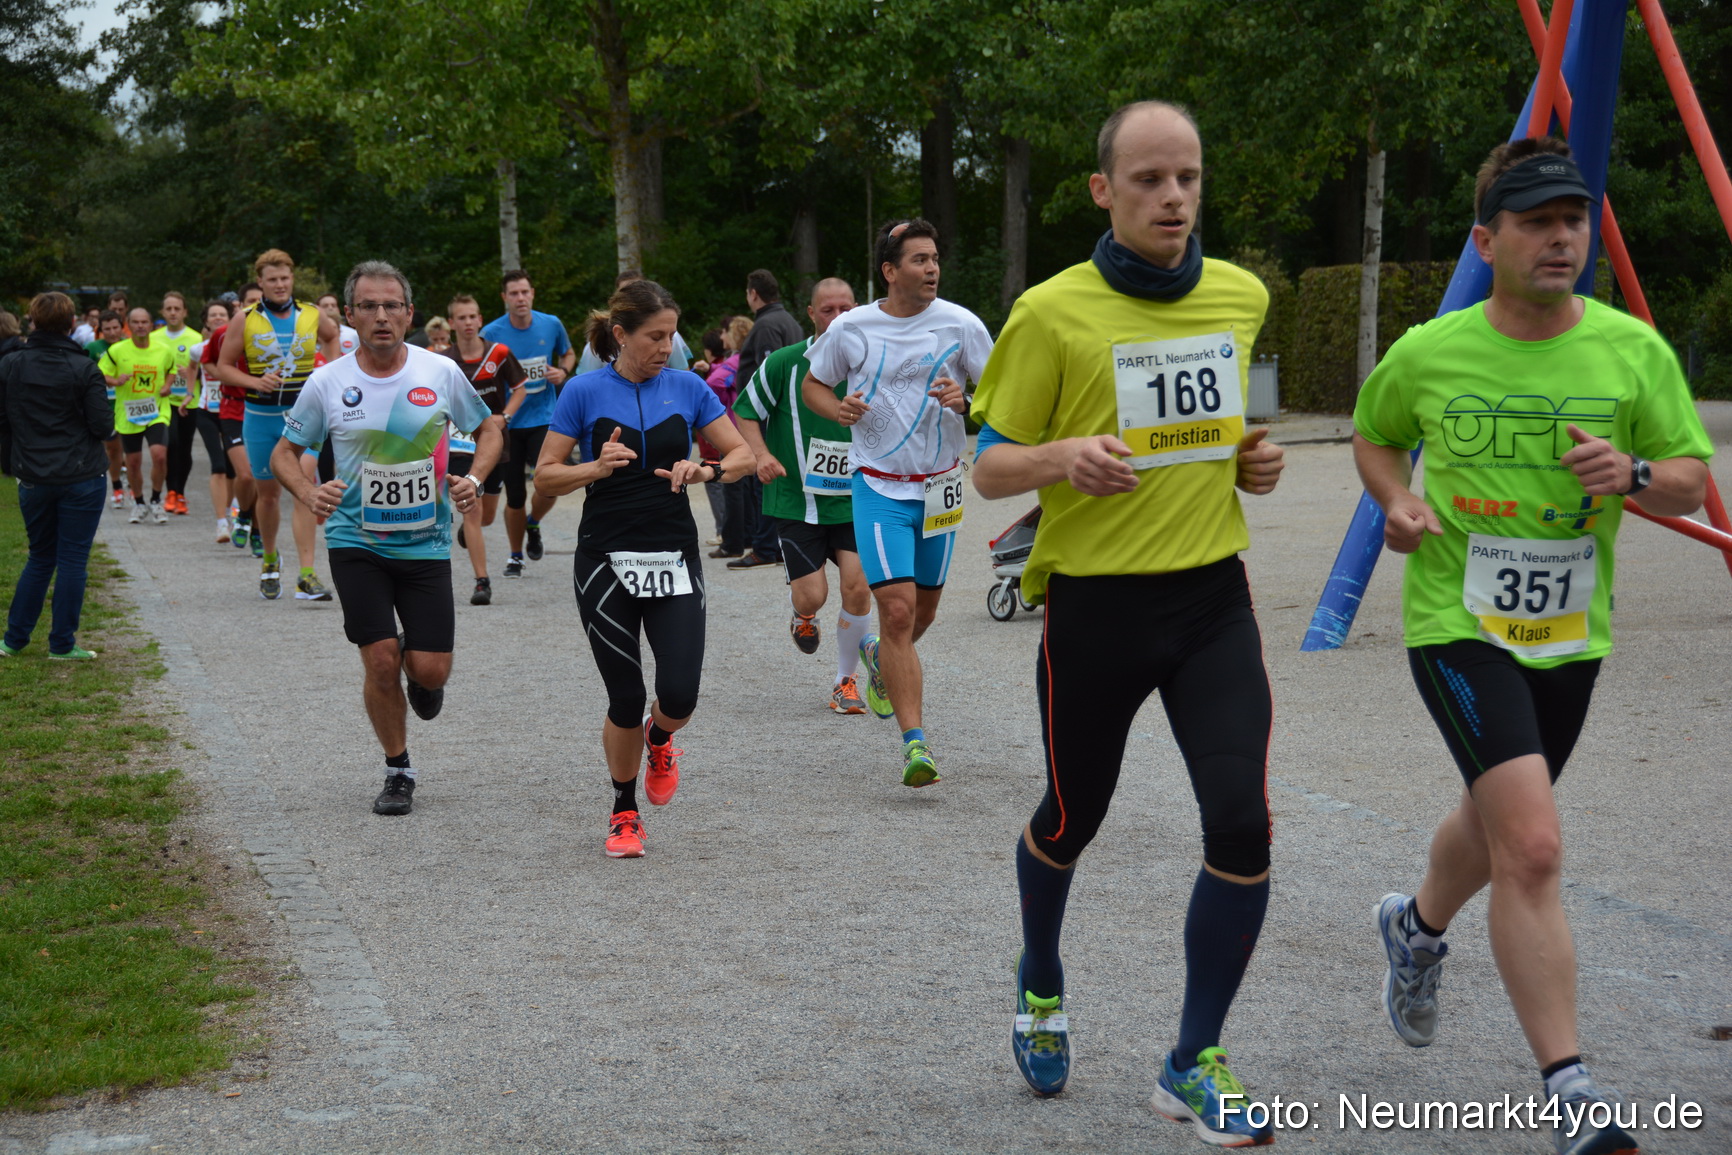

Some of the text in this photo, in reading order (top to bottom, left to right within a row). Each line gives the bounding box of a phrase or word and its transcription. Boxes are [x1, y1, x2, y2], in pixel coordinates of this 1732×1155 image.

[1117, 349, 1216, 369] PARTL Neumarkt
[138, 376, 151, 387] M
[1146, 367, 1222, 419] 168
[128, 403, 156, 417] 2390
[863, 358, 921, 450] adidas
[342, 409, 366, 418] PARTL
[343, 414, 367, 422] Neumarkt
[810, 442, 832, 452] PARTL
[1149, 427, 1221, 450] Christian
[363, 467, 424, 478] PARTL Neumarkt
[369, 475, 430, 506] 2815
[822, 479, 848, 489] Stefan
[943, 481, 963, 510] 69
[1452, 494, 1519, 518] MERZ
[1542, 507, 1606, 522] Bretschneider
[381, 509, 422, 522] Michael
[636, 559, 675, 567] Neumarkt
[1471, 545, 1581, 563] PARTL Neumarkt
[623, 570, 675, 598] 340
[1493, 567, 1573, 614] 351
[1506, 623, 1551, 642] Klaus
